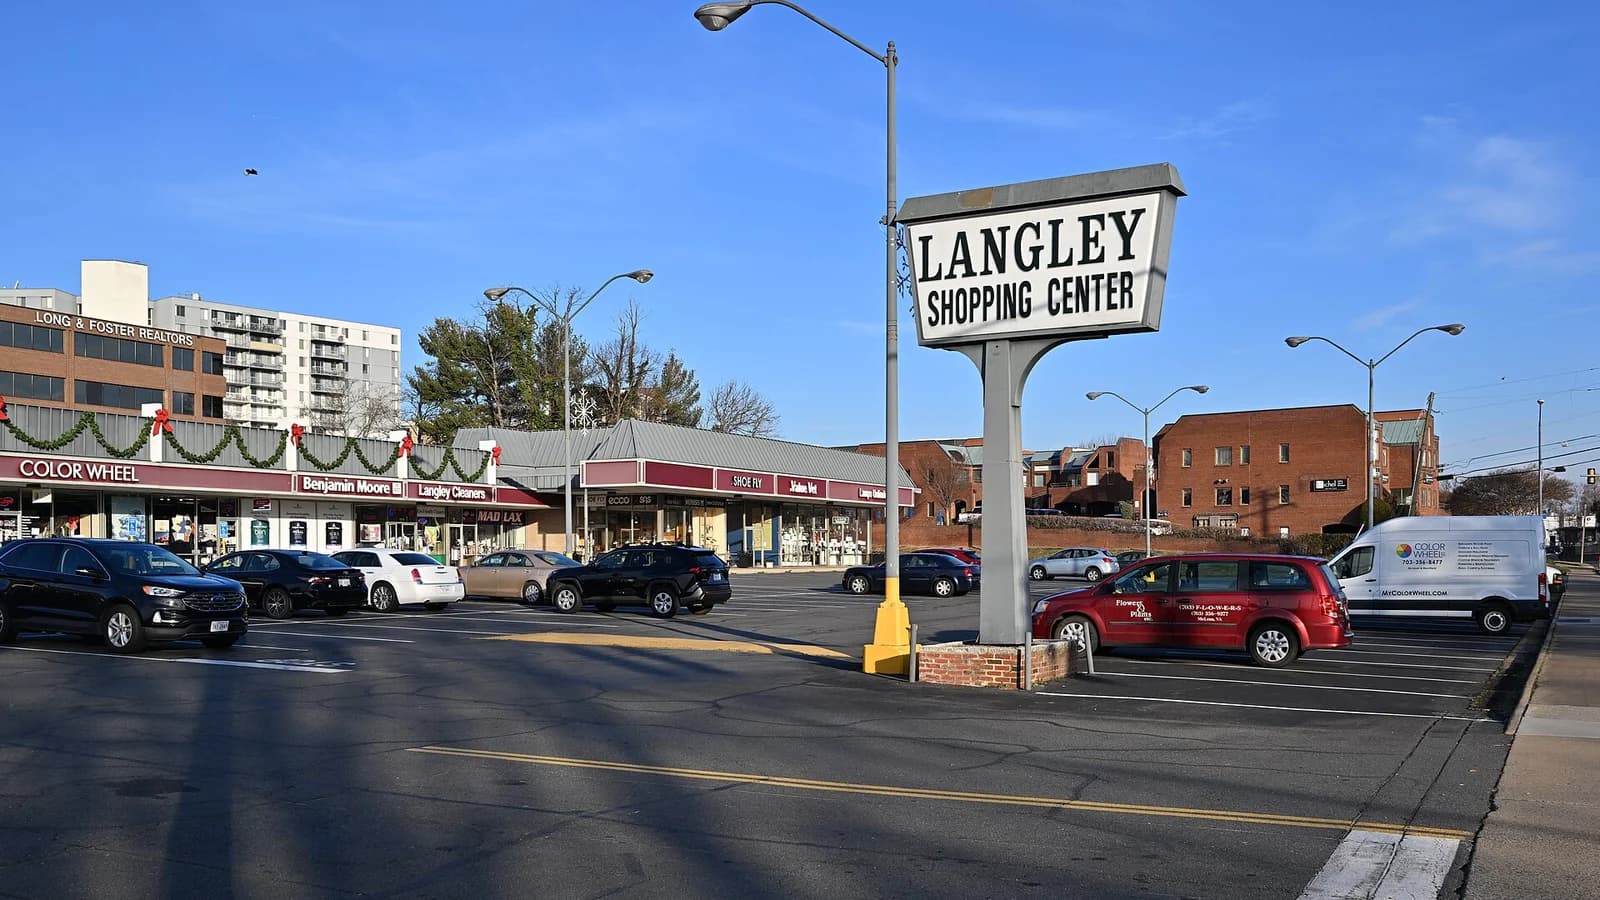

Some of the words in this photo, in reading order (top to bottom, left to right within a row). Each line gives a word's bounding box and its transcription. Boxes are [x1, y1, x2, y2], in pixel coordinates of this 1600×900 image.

[918, 208, 1146, 283] LANGLEY
[928, 280, 1032, 327] SHOPPING
[1048, 271, 1134, 316] CENTER
[36, 311, 72, 327] LONG
[75, 317, 84, 329] &
[88, 320, 136, 337] FOSTER
[138, 327, 194, 347] REALTORS
[20, 460, 84, 480] COLOR
[84, 463, 140, 483] WHEEL
[303, 476, 355, 495] Benjamin
[356, 479, 391, 495] Moore
[733, 475, 752, 488] SHOE
[752, 477, 763, 489] FLY
[418, 483, 451, 501] Langley
[452, 486, 487, 500] Cleaners
[608, 496, 630, 505] ecco
[478, 510, 500, 523] MAD
[503, 510, 524, 523] LAX
[1413, 550, 1443, 559] WHEEL
[1414, 542, 1446, 551] COLOR
[1116, 599, 1143, 607] Flowers
